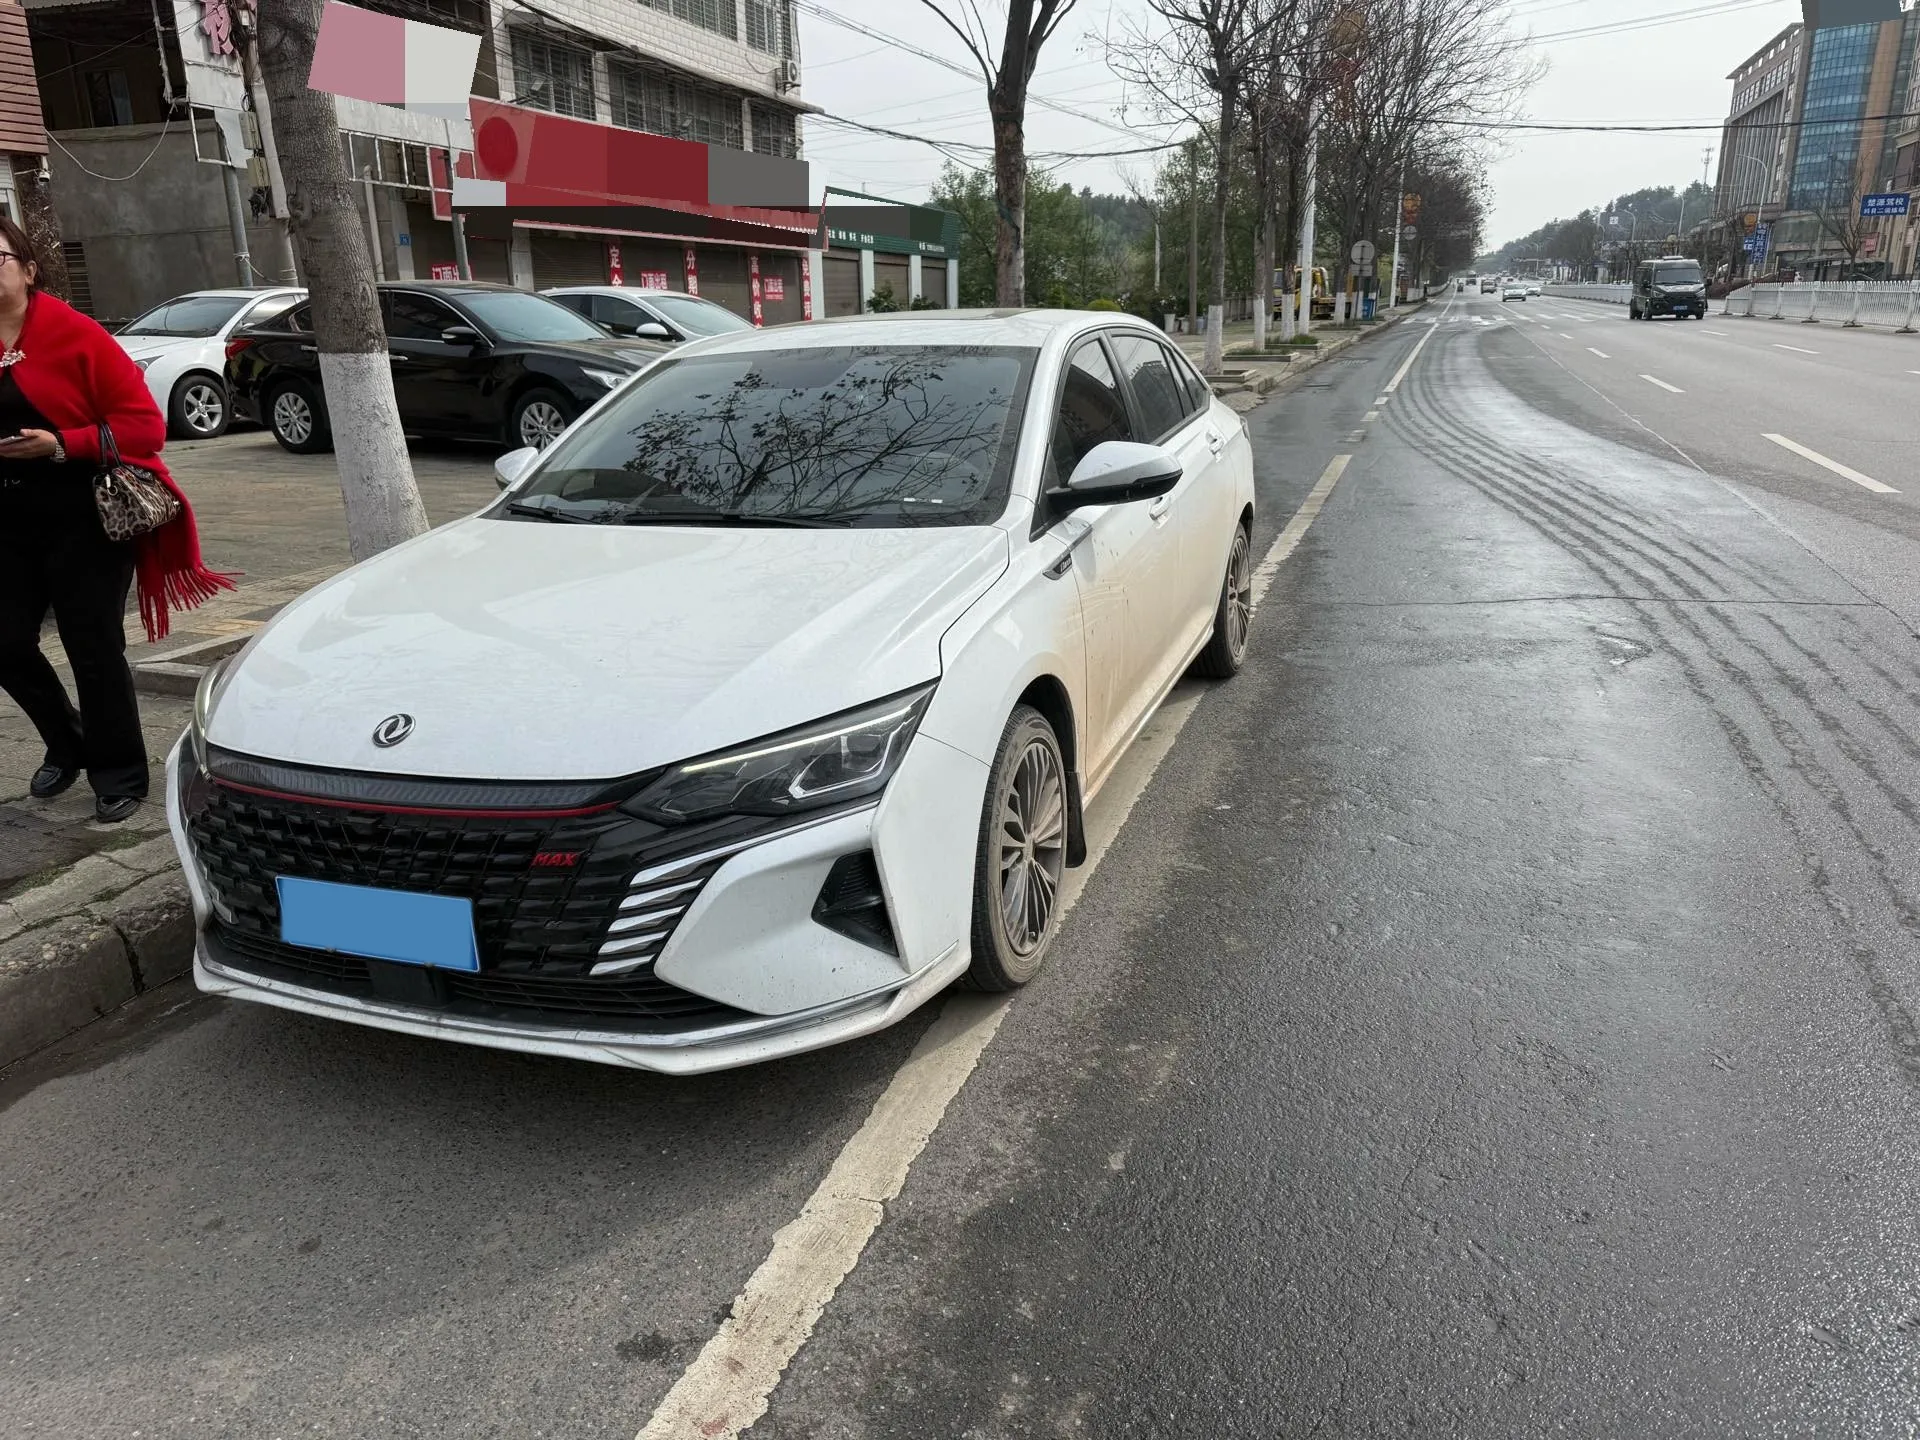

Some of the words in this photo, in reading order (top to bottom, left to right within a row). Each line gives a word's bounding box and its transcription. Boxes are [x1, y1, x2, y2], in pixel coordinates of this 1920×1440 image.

[641, 273, 668, 289] 门面出租
[686, 250, 698, 295] 分期
[751, 256, 762, 327] 高价收
[532, 853, 577, 866] MAX
